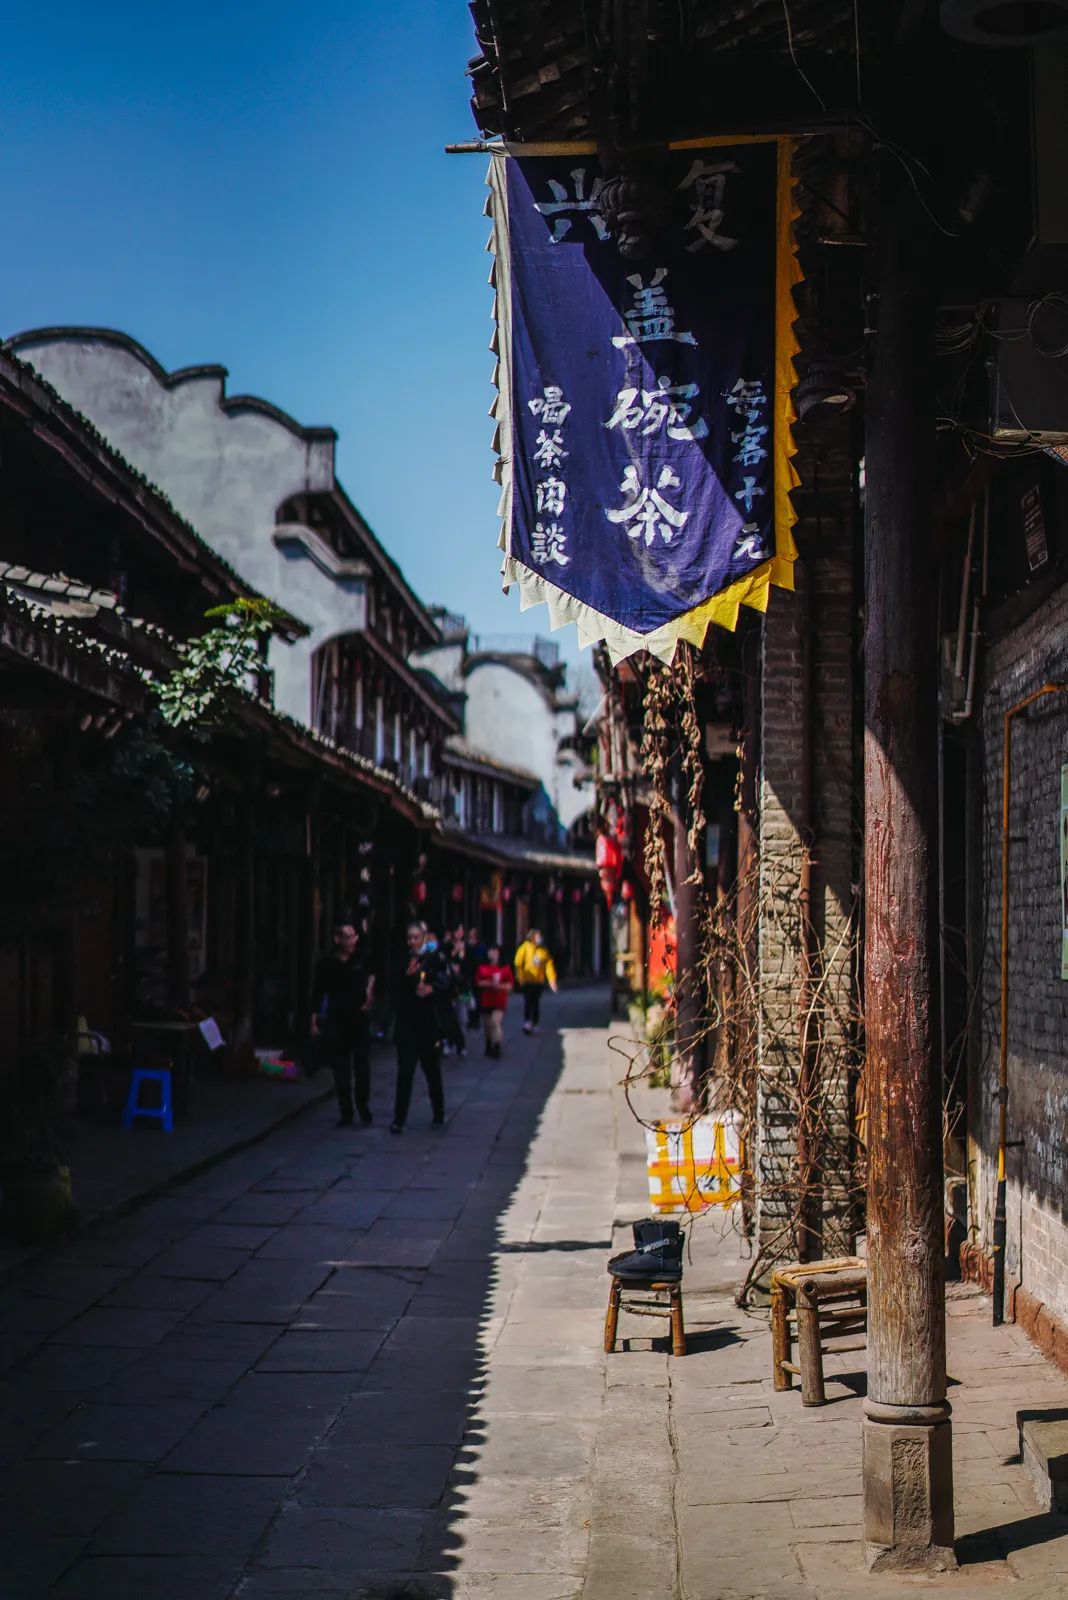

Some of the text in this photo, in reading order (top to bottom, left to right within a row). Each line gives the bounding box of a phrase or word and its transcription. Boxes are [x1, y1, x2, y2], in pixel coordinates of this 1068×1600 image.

[601, 267, 711, 547] 盖碗茶
[724, 377, 770, 560] 每客十元
